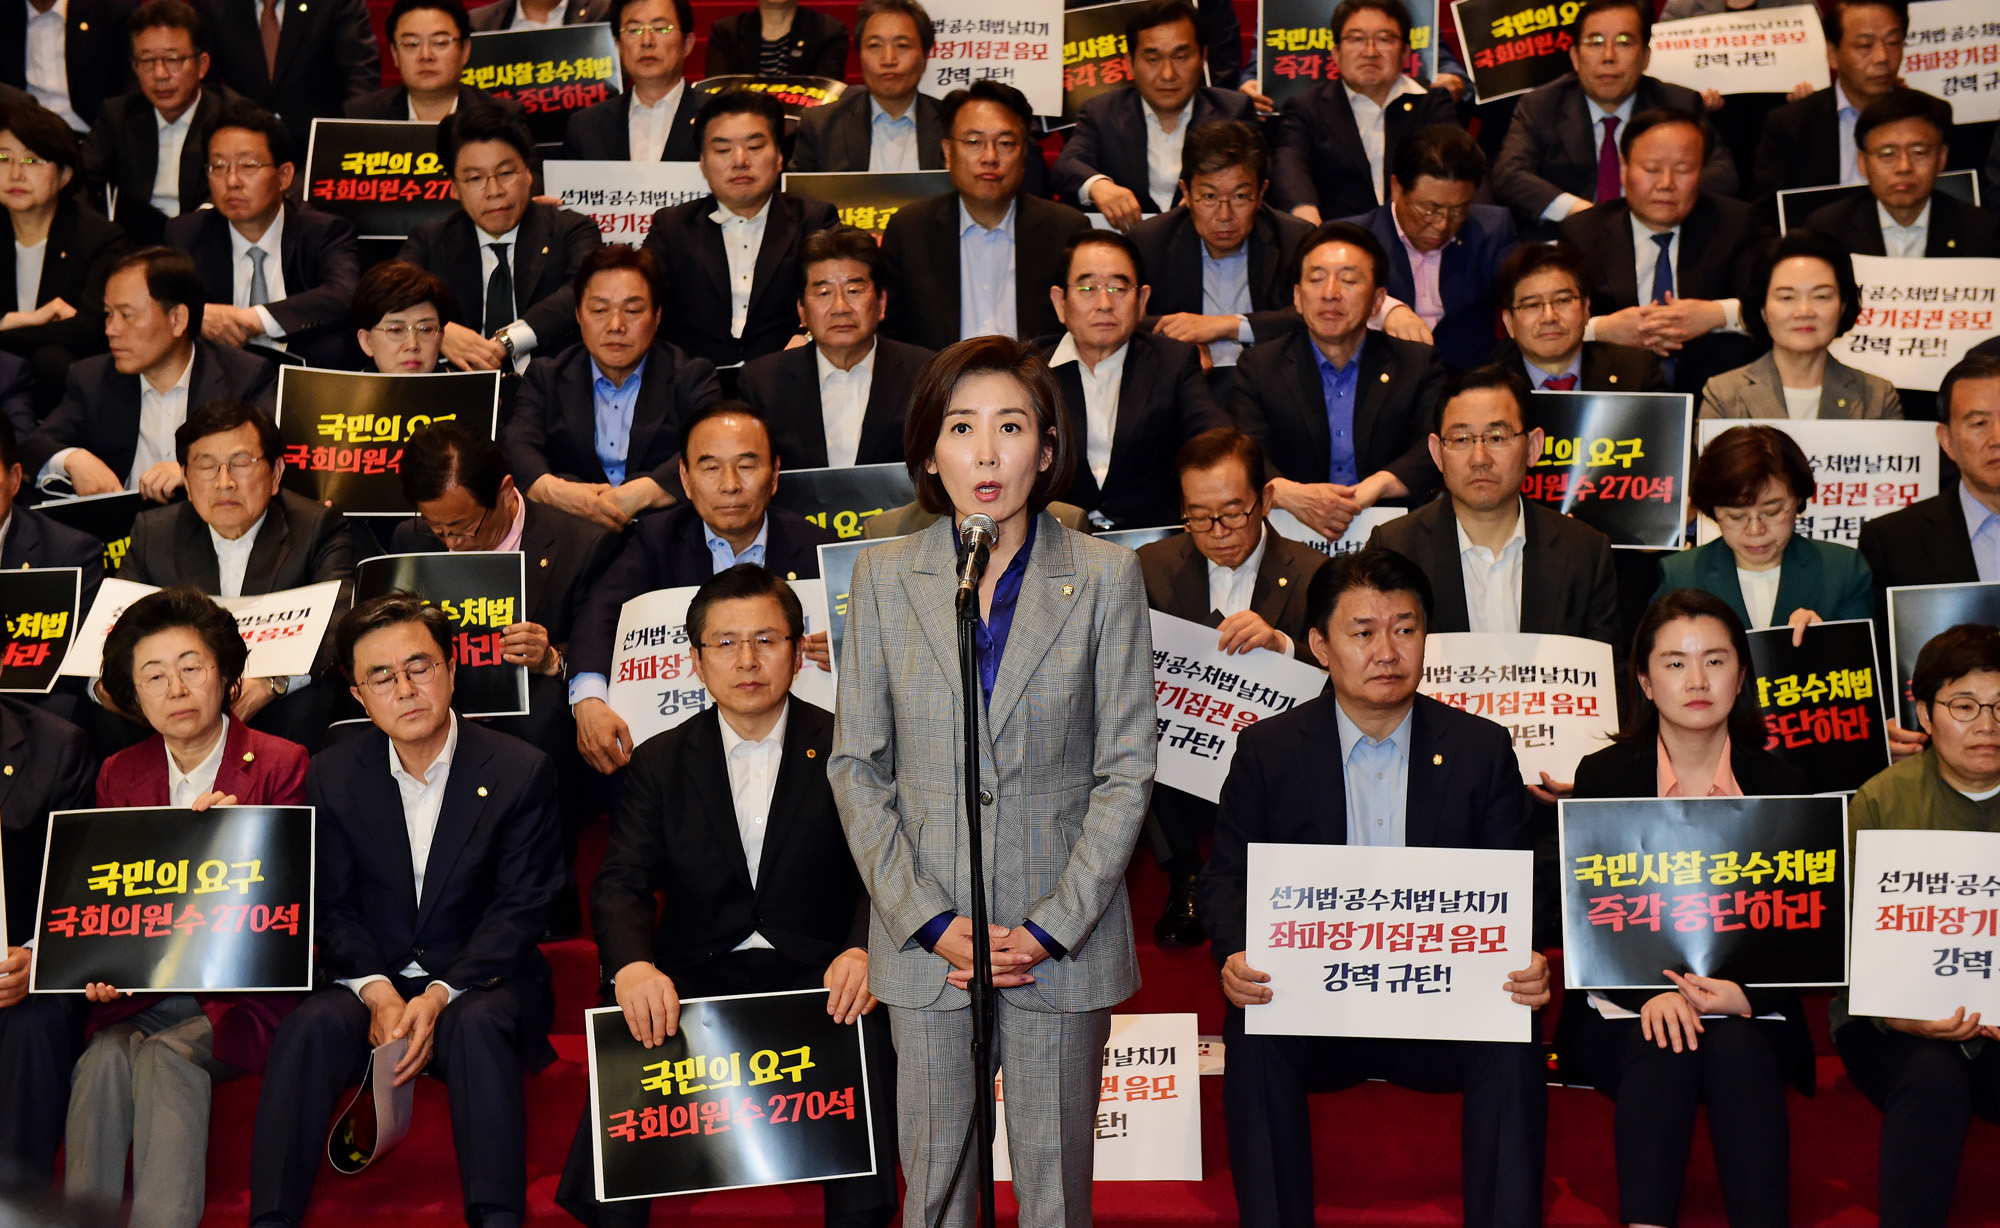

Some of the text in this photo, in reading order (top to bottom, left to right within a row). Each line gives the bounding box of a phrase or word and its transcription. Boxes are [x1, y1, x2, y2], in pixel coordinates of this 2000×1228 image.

[1008, 20, 1049, 36] 날치기
[1490, 0, 1588, 38] 국민의 요
[1014, 42, 1049, 61] 음모
[1694, 52, 1729, 69] 강력
[459, 56, 613, 89] 국민사찰 공수처법
[936, 67, 970, 86] 강력
[1273, 53, 1324, 80] 즉각
[1941, 74, 1978, 97] 강력
[341, 151, 447, 176] 국민의 요
[312, 178, 422, 202] 국회의원수
[1860, 284, 1995, 302] ·공수처법 날치기
[1948, 310, 1992, 330] 음모
[1849, 335, 1947, 357] 강력 규탄!
[317, 413, 401, 443] 국민의
[1586, 437, 1645, 468] 요구
[1865, 454, 1921, 474] 날치기
[1599, 475, 1674, 504] 270석
[1872, 482, 1919, 507] 음모
[1540, 666, 1597, 688] 날치기
[1773, 667, 1873, 708] 공수처법
[657, 687, 706, 716] 강력
[1236, 679, 1298, 711] 날치기
[1550, 693, 1600, 717] 음모
[1169, 724, 1226, 760] 규탄!
[87, 859, 264, 897] 국민의 요구
[1573, 848, 1837, 888] 국민사찰 공수처법
[1269, 885, 1508, 915] 선거법·공수처법 날치기
[1587, 889, 1826, 933] 즉각 중단하라
[47, 902, 300, 938] 국회의원수 270석
[1875, 904, 1998, 937] 좌파장기
[1268, 920, 1508, 954] 좌파장기집권 음모
[1323, 962, 1452, 994] 강력 규탄!
[1933, 947, 1993, 980] 강력
[640, 1045, 816, 1096] 국민의 요구
[1114, 1046, 1176, 1067] 날치기
[1123, 1074, 1178, 1102] 음모
[607, 1086, 856, 1143] 국회의원수 270석
